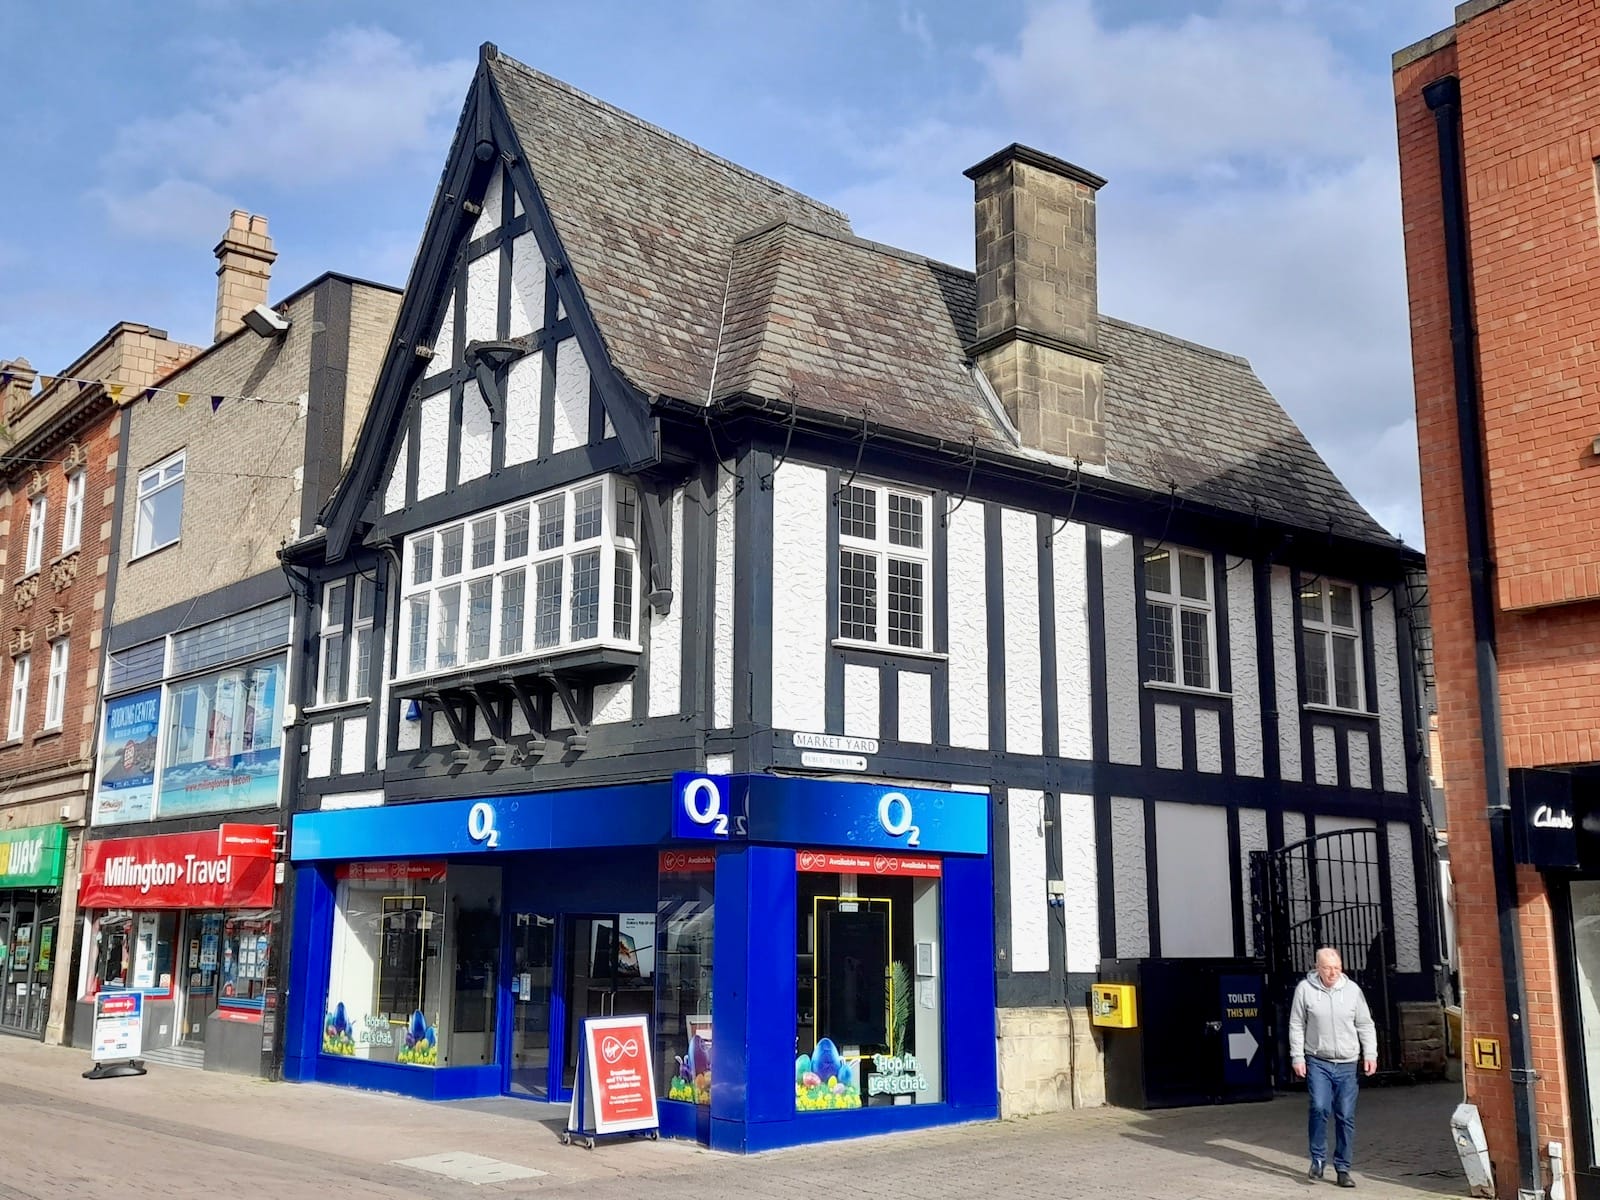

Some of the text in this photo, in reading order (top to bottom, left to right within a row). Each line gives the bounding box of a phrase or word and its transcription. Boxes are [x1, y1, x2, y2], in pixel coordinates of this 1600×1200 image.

[111, 699, 157, 728] BOOKING CENTRE
[796, 734, 876, 752] MARKET YARD
[1534, 804, 1573, 830] Clarks
[829, 857, 855, 867] Available
[901, 861, 926, 870] Available
[104, 854, 231, 894] Millington Travel
[1227, 993, 1257, 1004] TOILETS
[1227, 1008, 1258, 1018] THIS WAY
[1478, 1041, 1497, 1066] H
[879, 1058, 902, 1074] Hop
[870, 1077, 897, 1092] Let's
